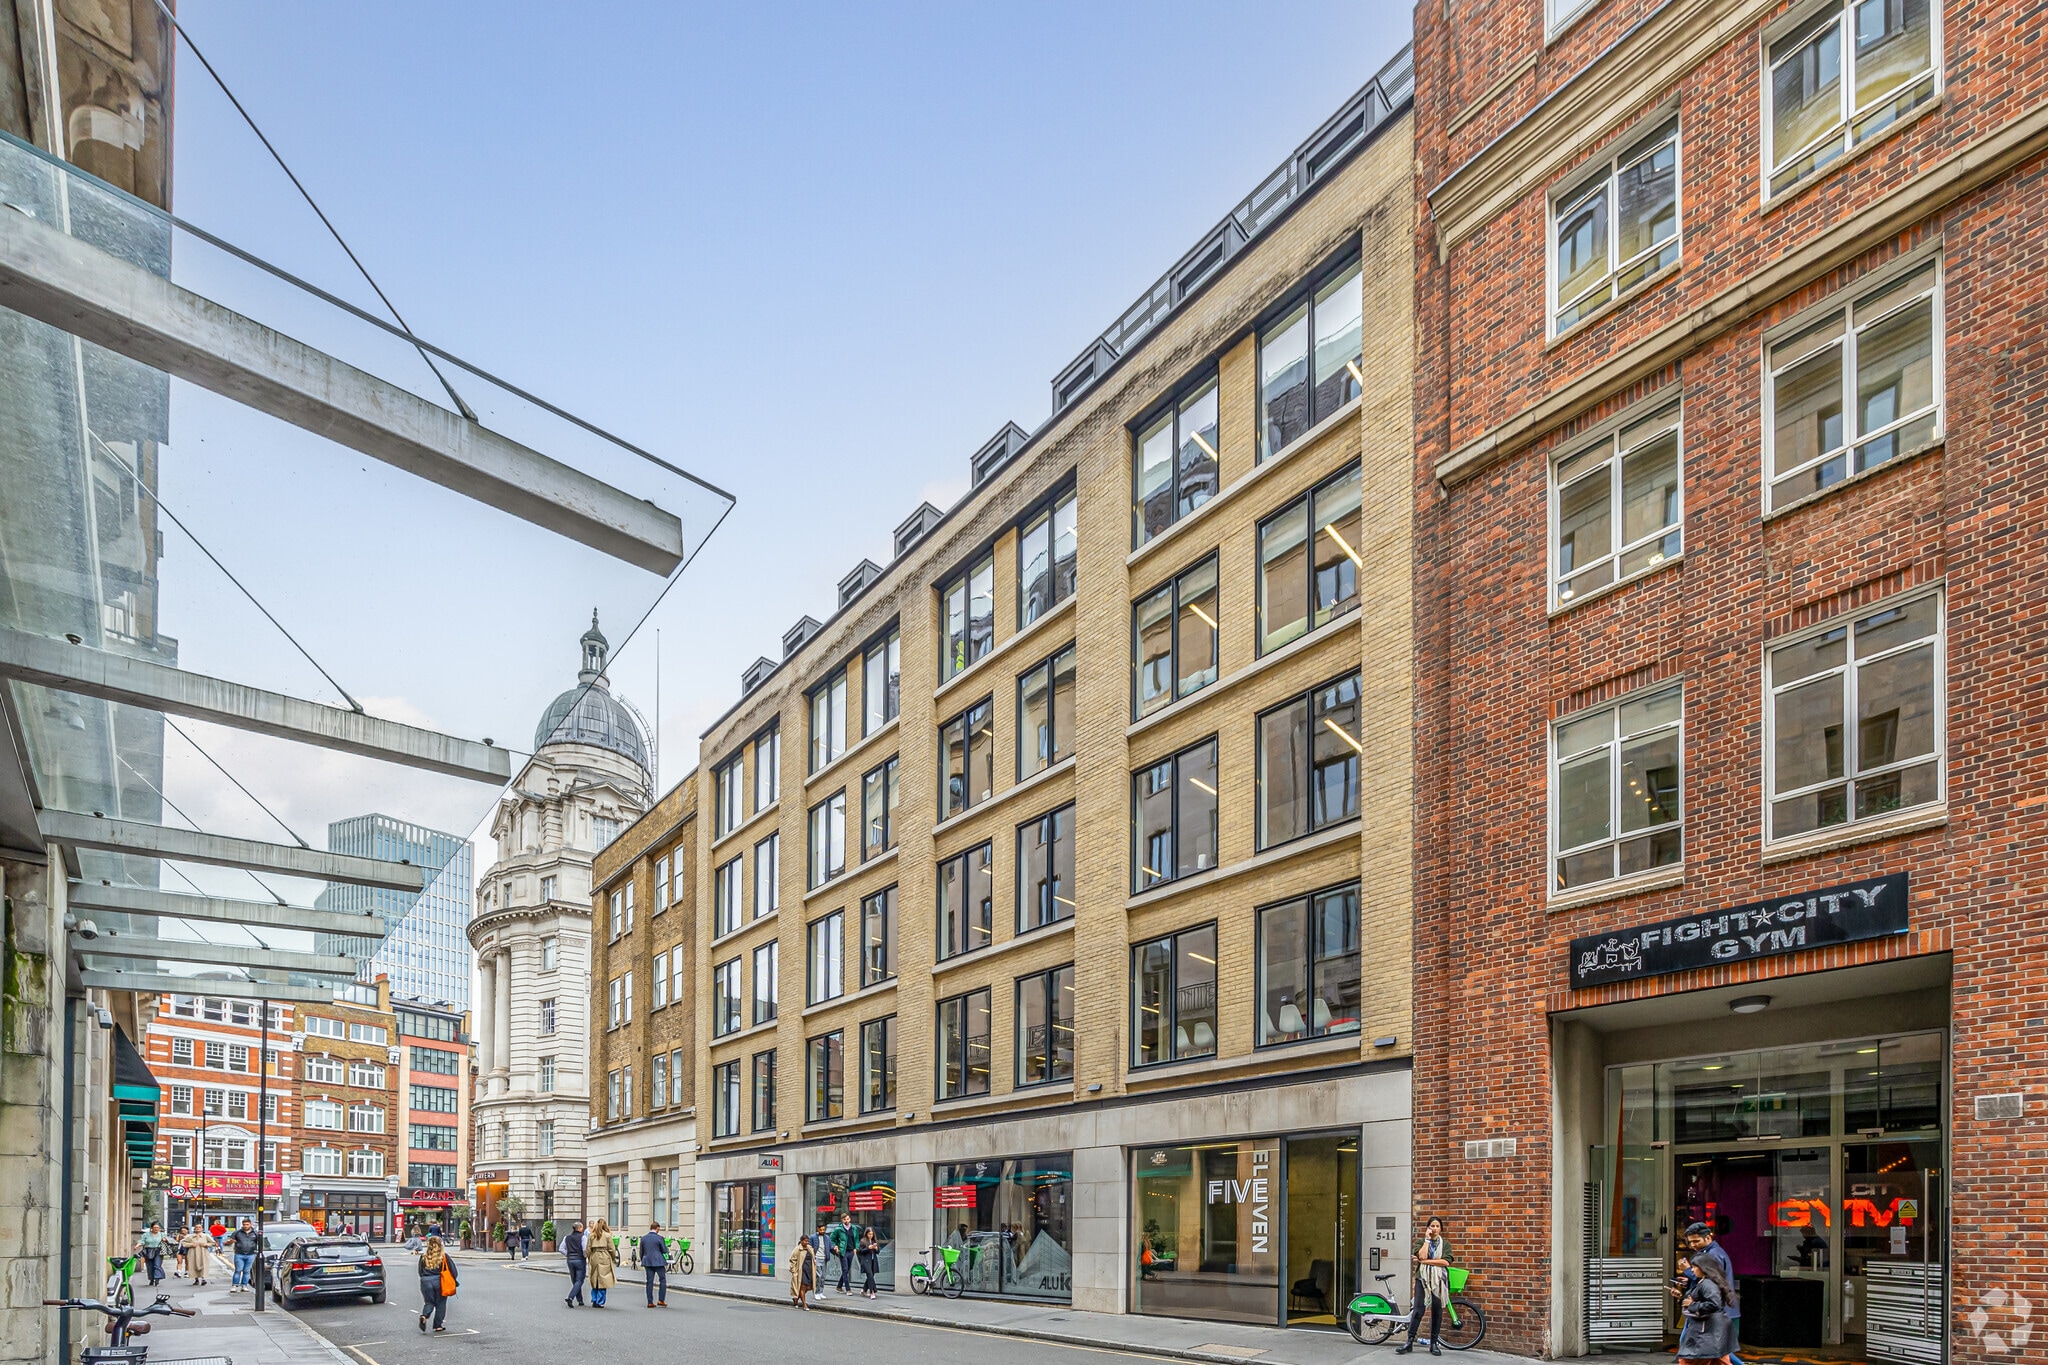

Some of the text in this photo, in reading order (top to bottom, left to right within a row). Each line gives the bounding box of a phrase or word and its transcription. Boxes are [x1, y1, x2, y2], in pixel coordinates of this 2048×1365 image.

[1640, 883, 1888, 949] FIGHT CITY
[1710, 925, 1806, 959] GYM
[243, 1178, 275, 1186] Sichan
[412, 1189, 455, 1200] ADANA
[1208, 1178, 1269, 1204] FIVE
[1251, 1149, 1269, 1253] ELEVEN
[1768, 1198, 1914, 1228] GYM
[1376, 1232, 1396, 1241] 5-11
